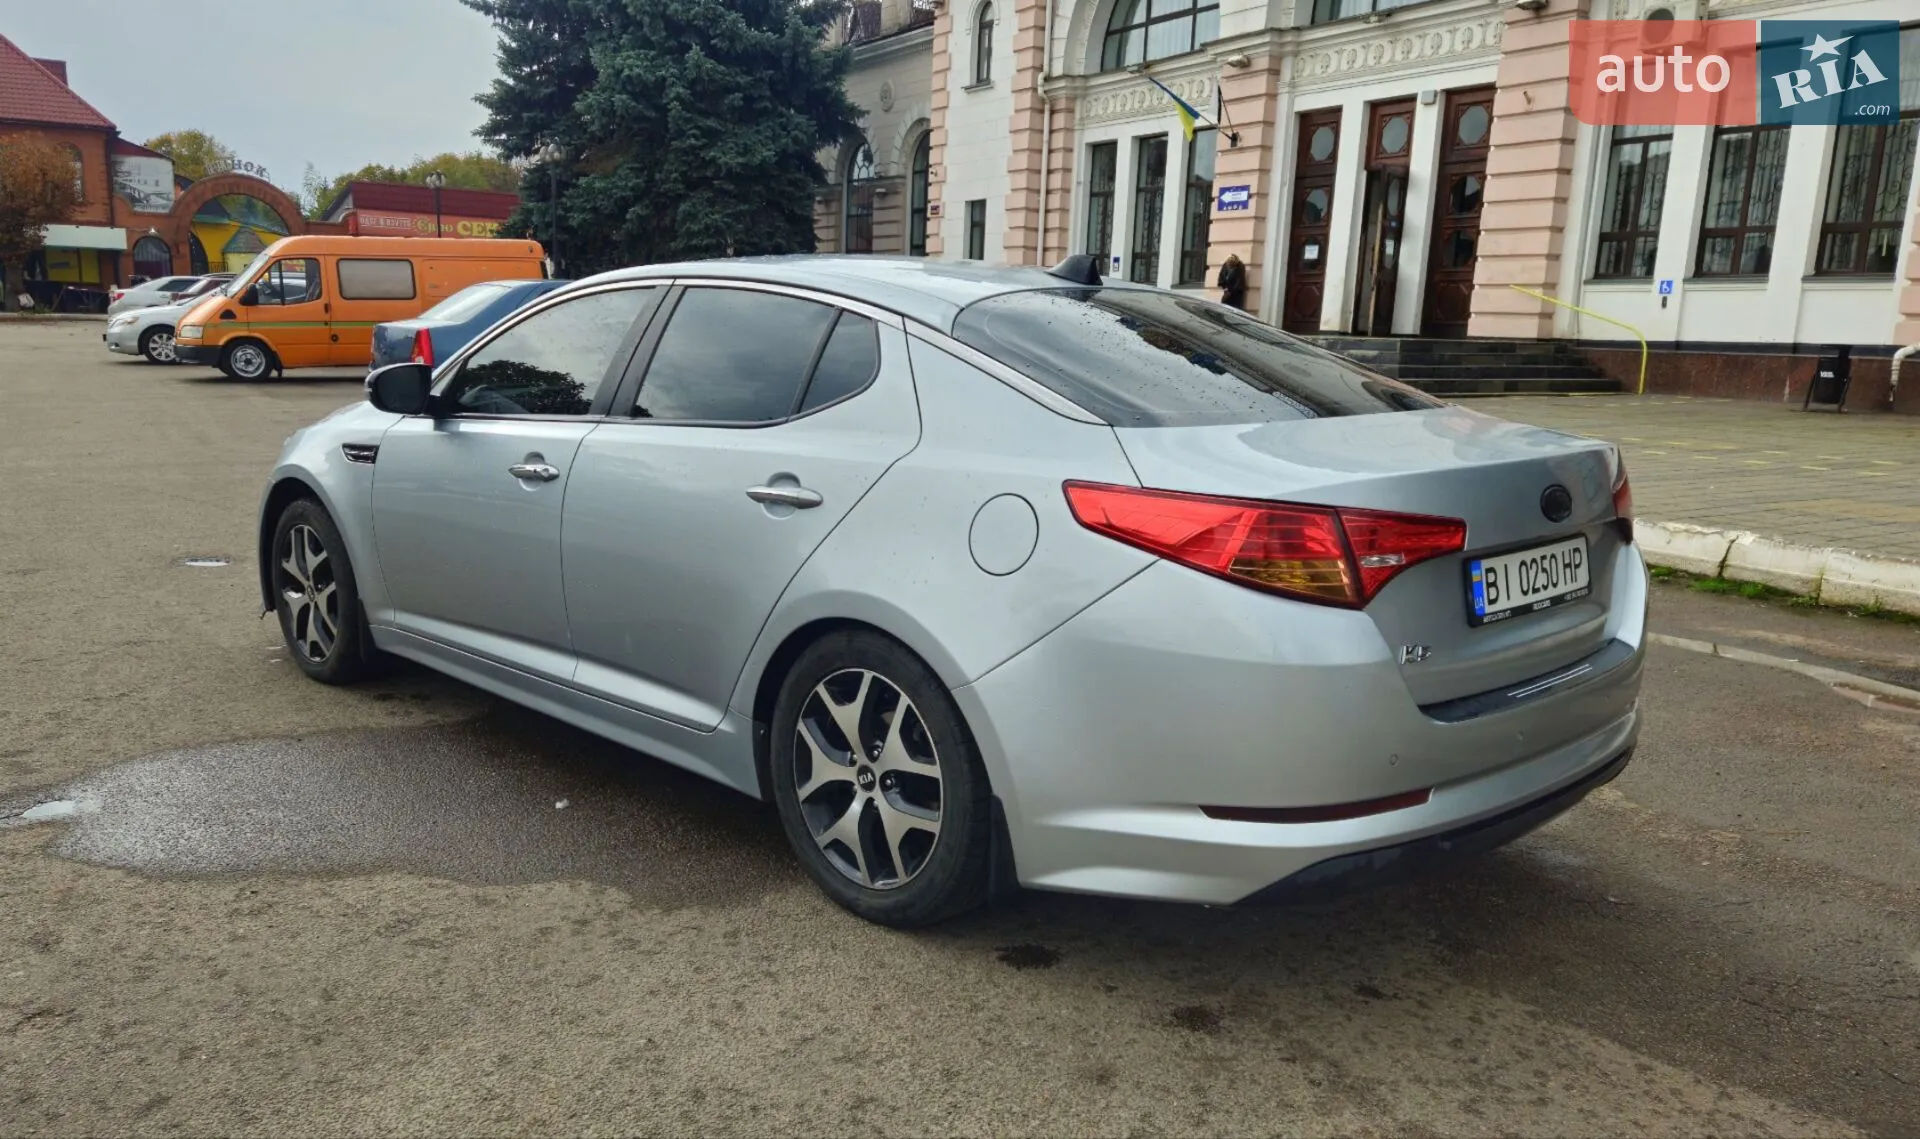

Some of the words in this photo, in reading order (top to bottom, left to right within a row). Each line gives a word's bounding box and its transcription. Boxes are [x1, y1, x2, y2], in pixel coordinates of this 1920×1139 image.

[1485, 563, 1511, 606] BI
[1518, 553, 1559, 597] 0250
[1562, 547, 1583, 586] HP
[858, 772, 874, 785] KIA
